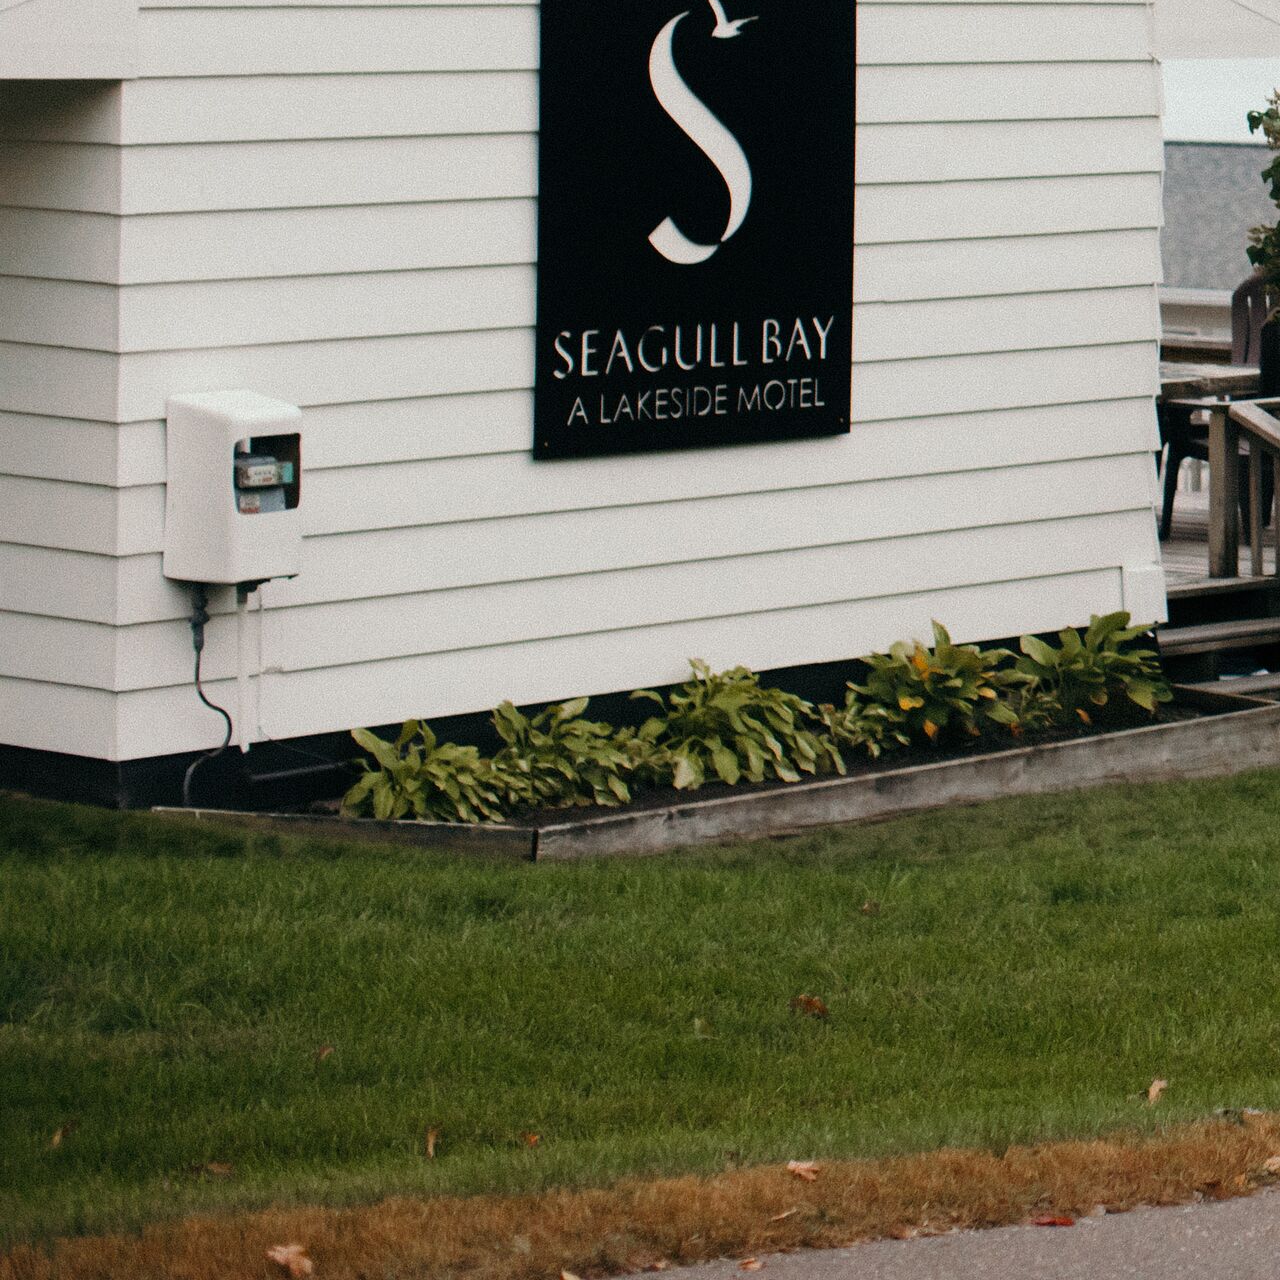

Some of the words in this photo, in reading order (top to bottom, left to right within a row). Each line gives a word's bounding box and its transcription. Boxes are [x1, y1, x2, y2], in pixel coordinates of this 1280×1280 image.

[553, 322, 748, 379] SEAGULL
[762, 316, 834, 363] BAY
[567, 396, 589, 426] A
[600, 384, 728, 423] LAKESIDE
[738, 378, 825, 412] MOTEL
